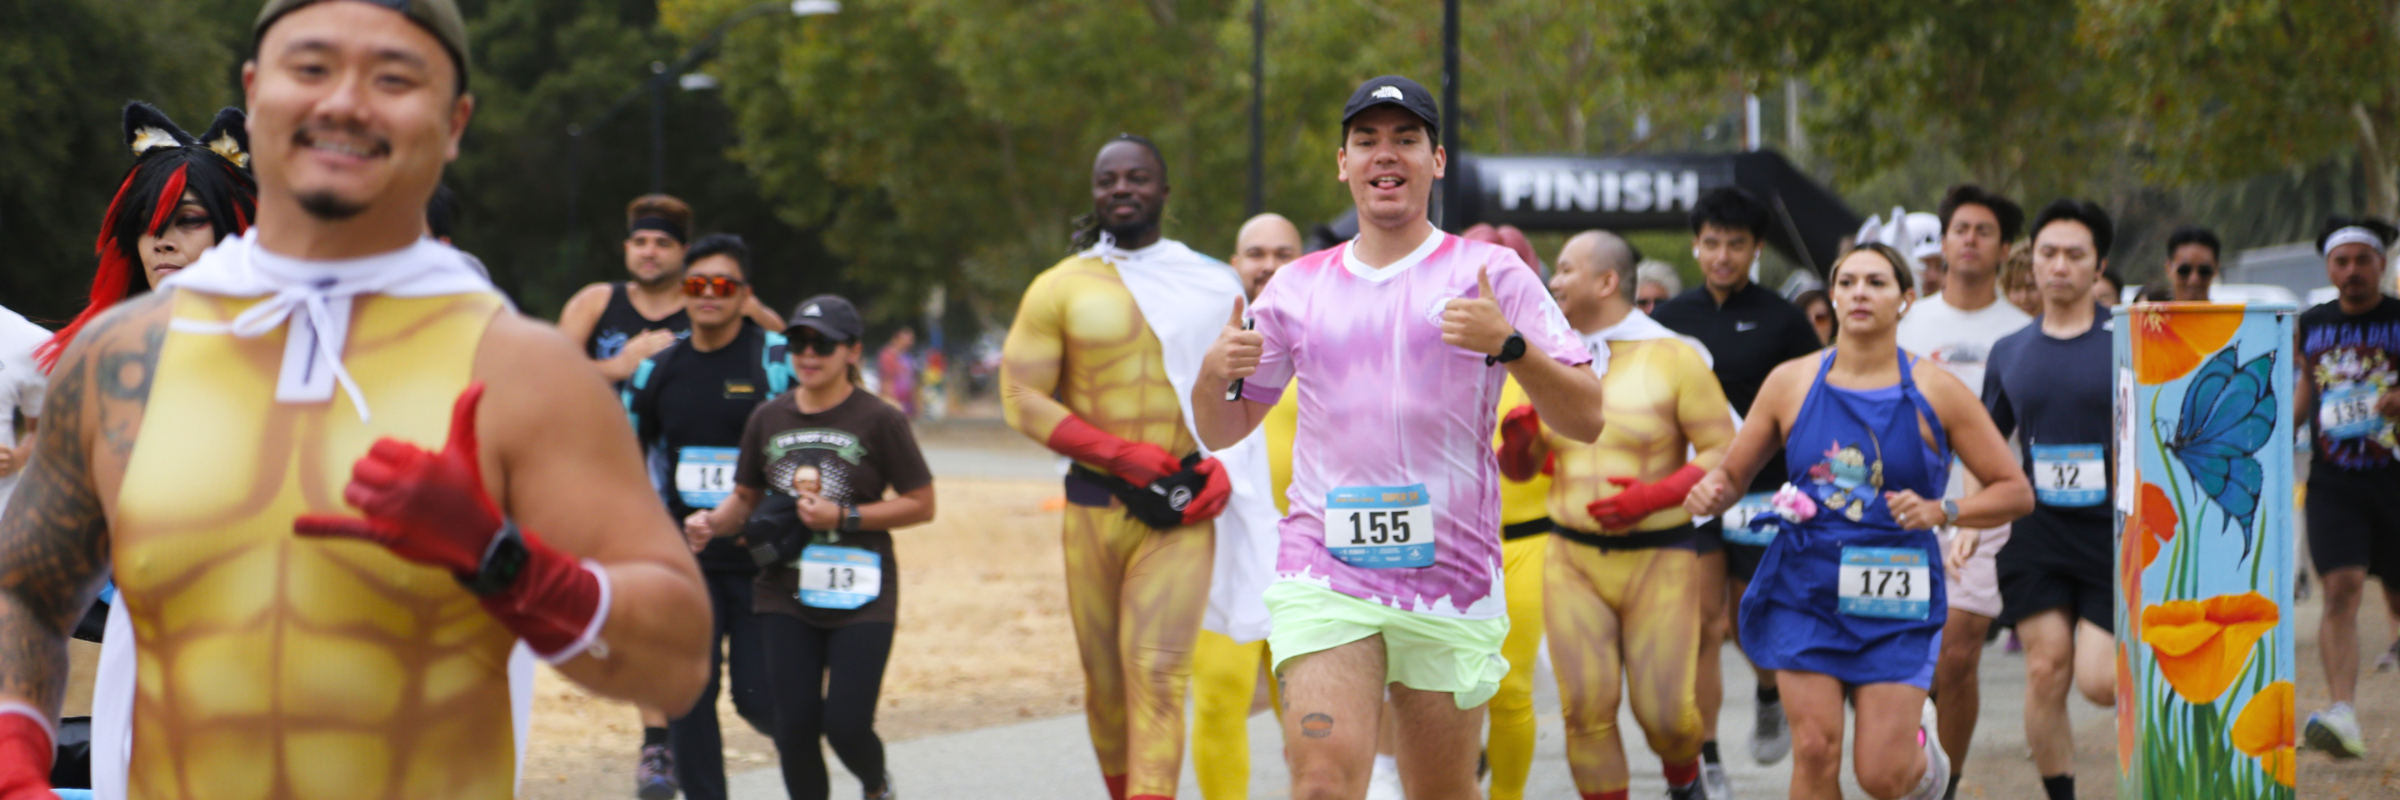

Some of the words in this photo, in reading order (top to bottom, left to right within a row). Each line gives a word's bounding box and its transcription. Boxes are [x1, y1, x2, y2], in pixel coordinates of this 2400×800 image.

[1501, 169, 1699, 212] FINISH
[700, 467, 723, 490] 14
[2052, 463, 2081, 489] 32
[1349, 510, 1411, 545] 155
[828, 566, 855, 590] 13
[1860, 570, 1911, 597] 173
